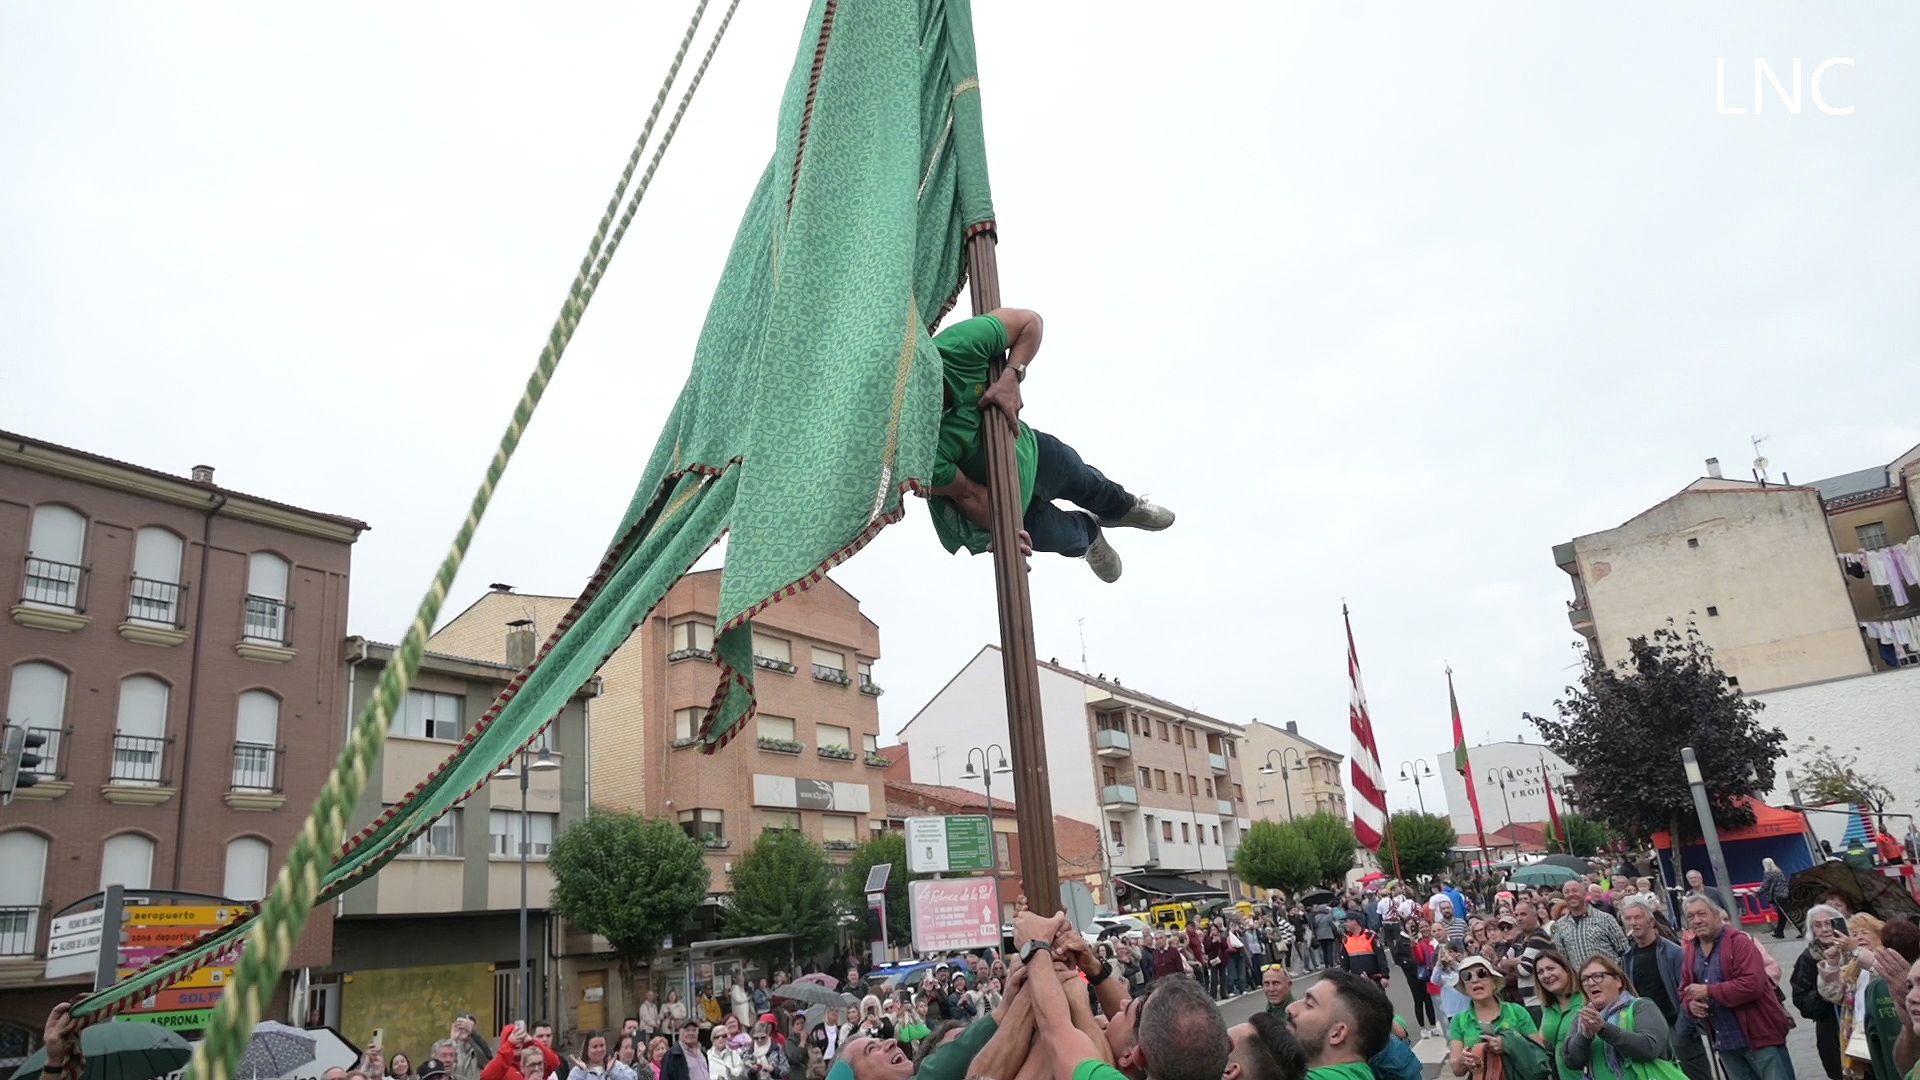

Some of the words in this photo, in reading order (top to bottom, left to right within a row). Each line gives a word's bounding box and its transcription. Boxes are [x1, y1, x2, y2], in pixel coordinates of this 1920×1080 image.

[134, 911, 196, 921] aeropuerto
[155, 933, 196, 943] deportiva
[151, 1014, 199, 1027] ASPRONA
